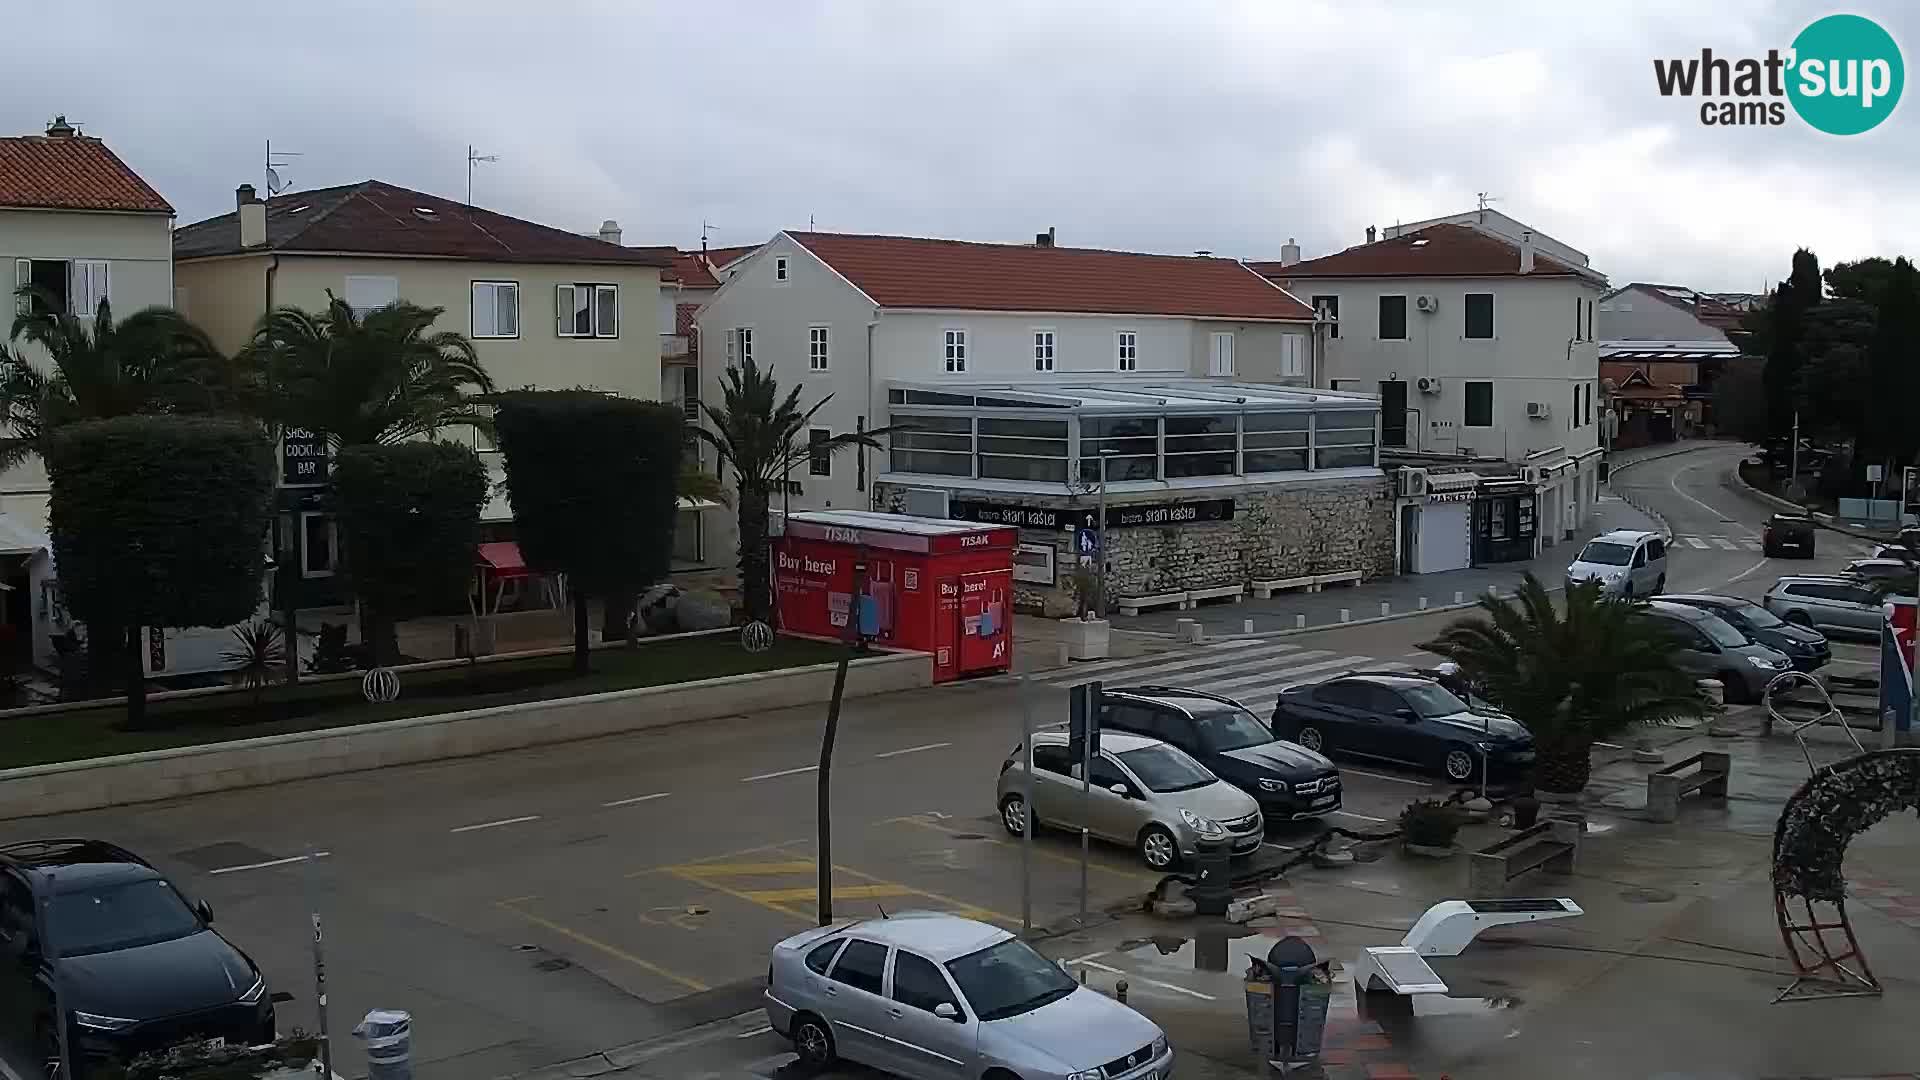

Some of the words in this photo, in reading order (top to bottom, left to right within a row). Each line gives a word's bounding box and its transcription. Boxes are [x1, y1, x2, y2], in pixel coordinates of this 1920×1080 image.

[297, 461, 316, 475] BAR
[824, 526, 860, 543] TISAK
[960, 535, 989, 547] TISAK
[779, 551, 802, 572] Buy
[804, 554, 836, 576] here!
[941, 583, 959, 597] Buy
[963, 579, 987, 593] here!
